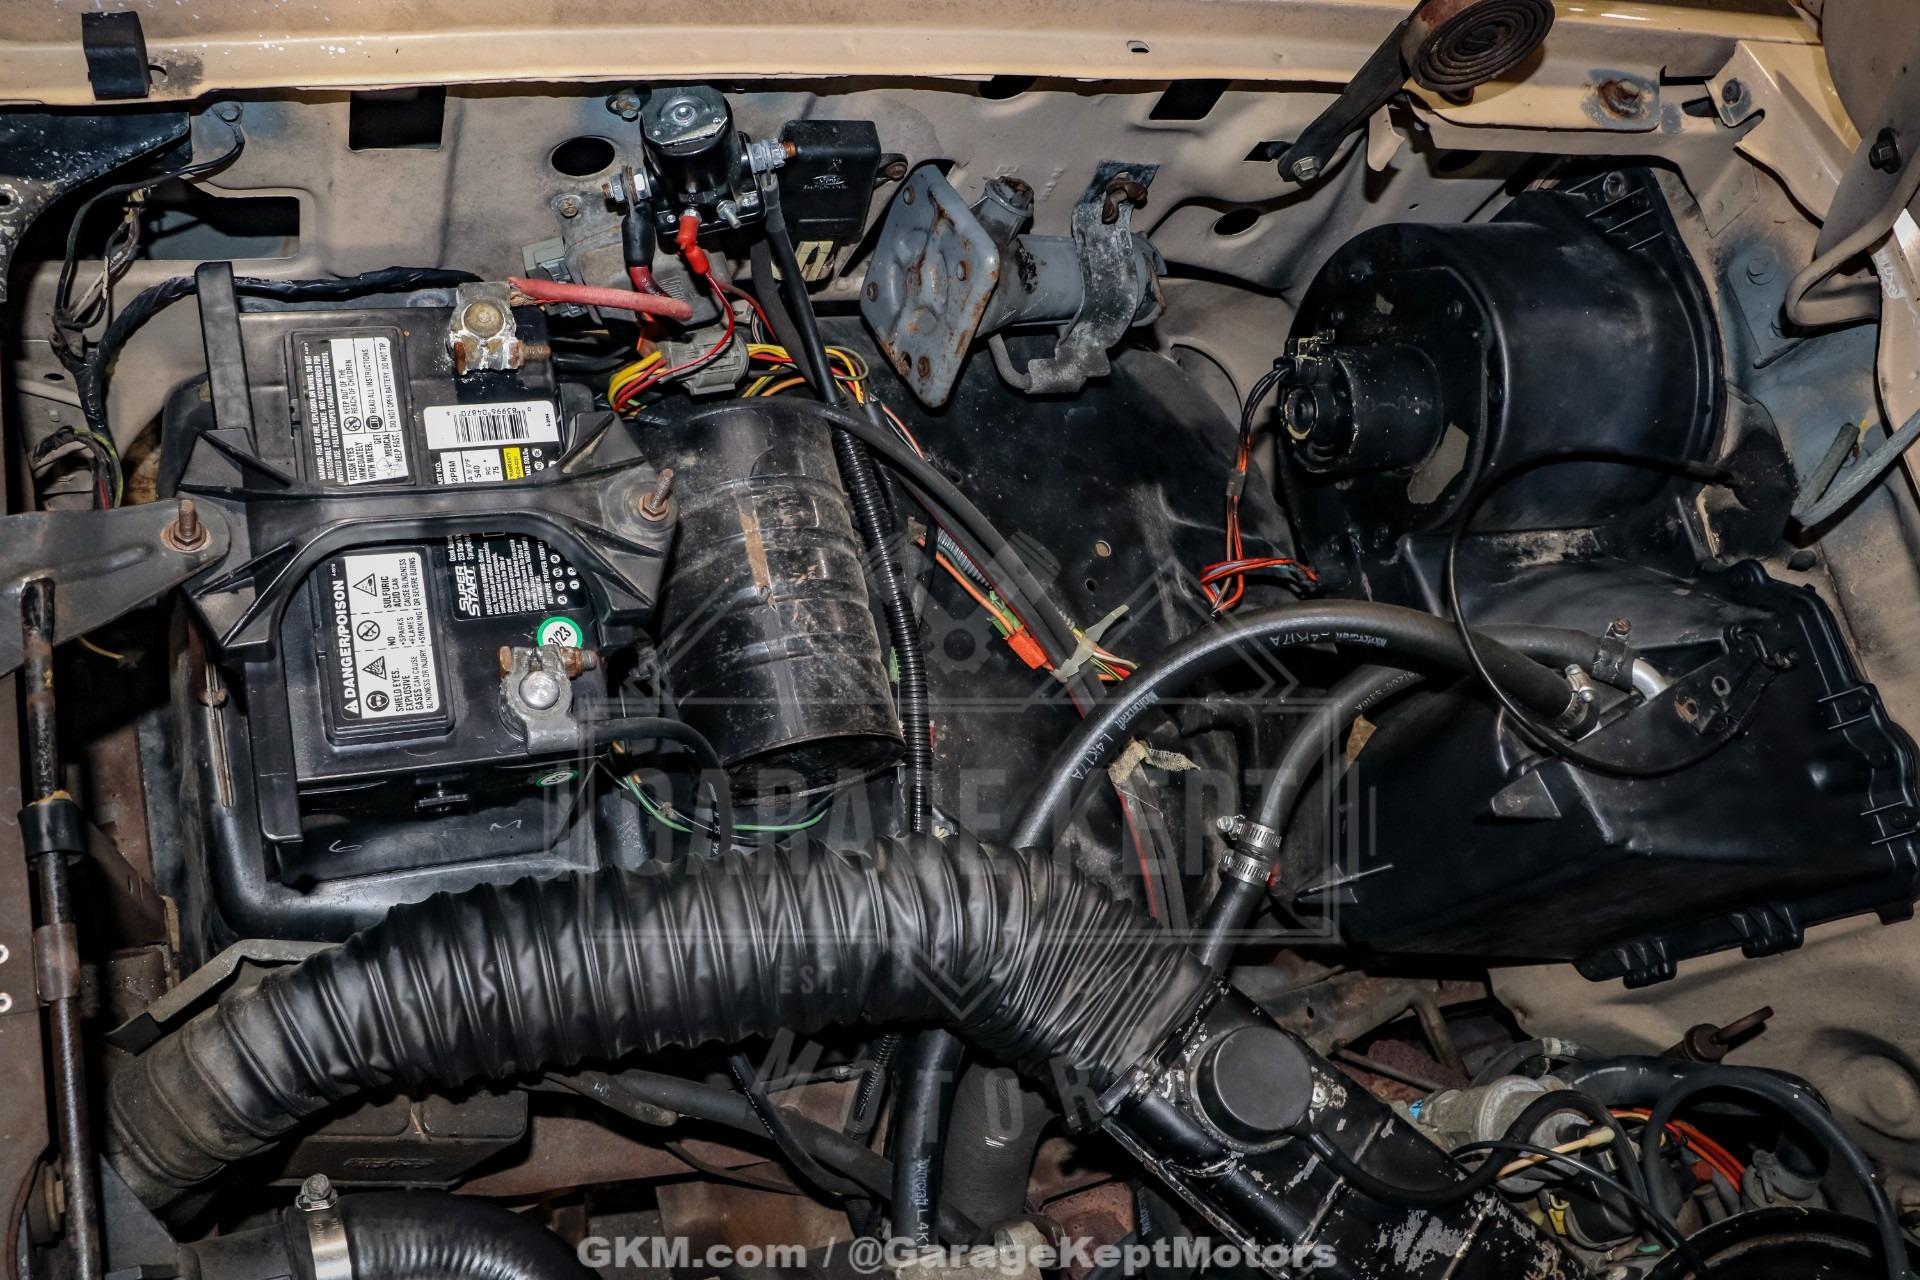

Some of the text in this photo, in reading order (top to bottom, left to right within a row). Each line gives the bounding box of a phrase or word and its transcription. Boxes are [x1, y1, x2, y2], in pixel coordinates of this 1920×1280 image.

[345, 360, 354, 386] CHILDREN
[362, 349, 373, 387] INSTRUCTIONS
[315, 365, 325, 399] RECOMMENDED
[325, 385, 334, 408] CHARGING
[385, 394, 394, 408] OPEN
[310, 398, 319, 423] EXPLOSION
[328, 409, 337, 428] PROPER
[387, 409, 395, 419] NOT
[331, 429, 339, 448] FOLLOW
[373, 434, 381, 444] GET
[383, 434, 392, 457] MEDICAL
[355, 442, 367, 480] IMMEDIATELY
[366, 442, 376, 479] WITH WATER.
[394, 449, 403, 462] HELP
[335, 461, 344, 482] INVERTED
[348, 462, 358, 480] FLUSH
[485, 467, 492, 475] RC
[493, 466, 499, 474] 75
[409, 557, 417, 576] BURNS
[541, 561, 550, 581] PROPER
[381, 576, 392, 608] SULFURIC
[399, 559, 411, 606] CAUSE BLINDNESS
[411, 577, 419, 597] SEVERE
[455, 566, 469, 611] SUPER
[392, 592, 402, 607] ACID
[544, 583, 554, 604] REMOVE
[333, 580, 356, 698] DANGER/POISON
[388, 636, 396, 646] NO
[411, 656, 419, 674] CAUSE
[420, 649, 428, 668] INJURY
[392, 668, 404, 712] SHIELD EYES.
[402, 675, 414, 710] EXPLOSIVE
[413, 689, 424, 710] GASES
[423, 679, 434, 709] BLINDNESS
